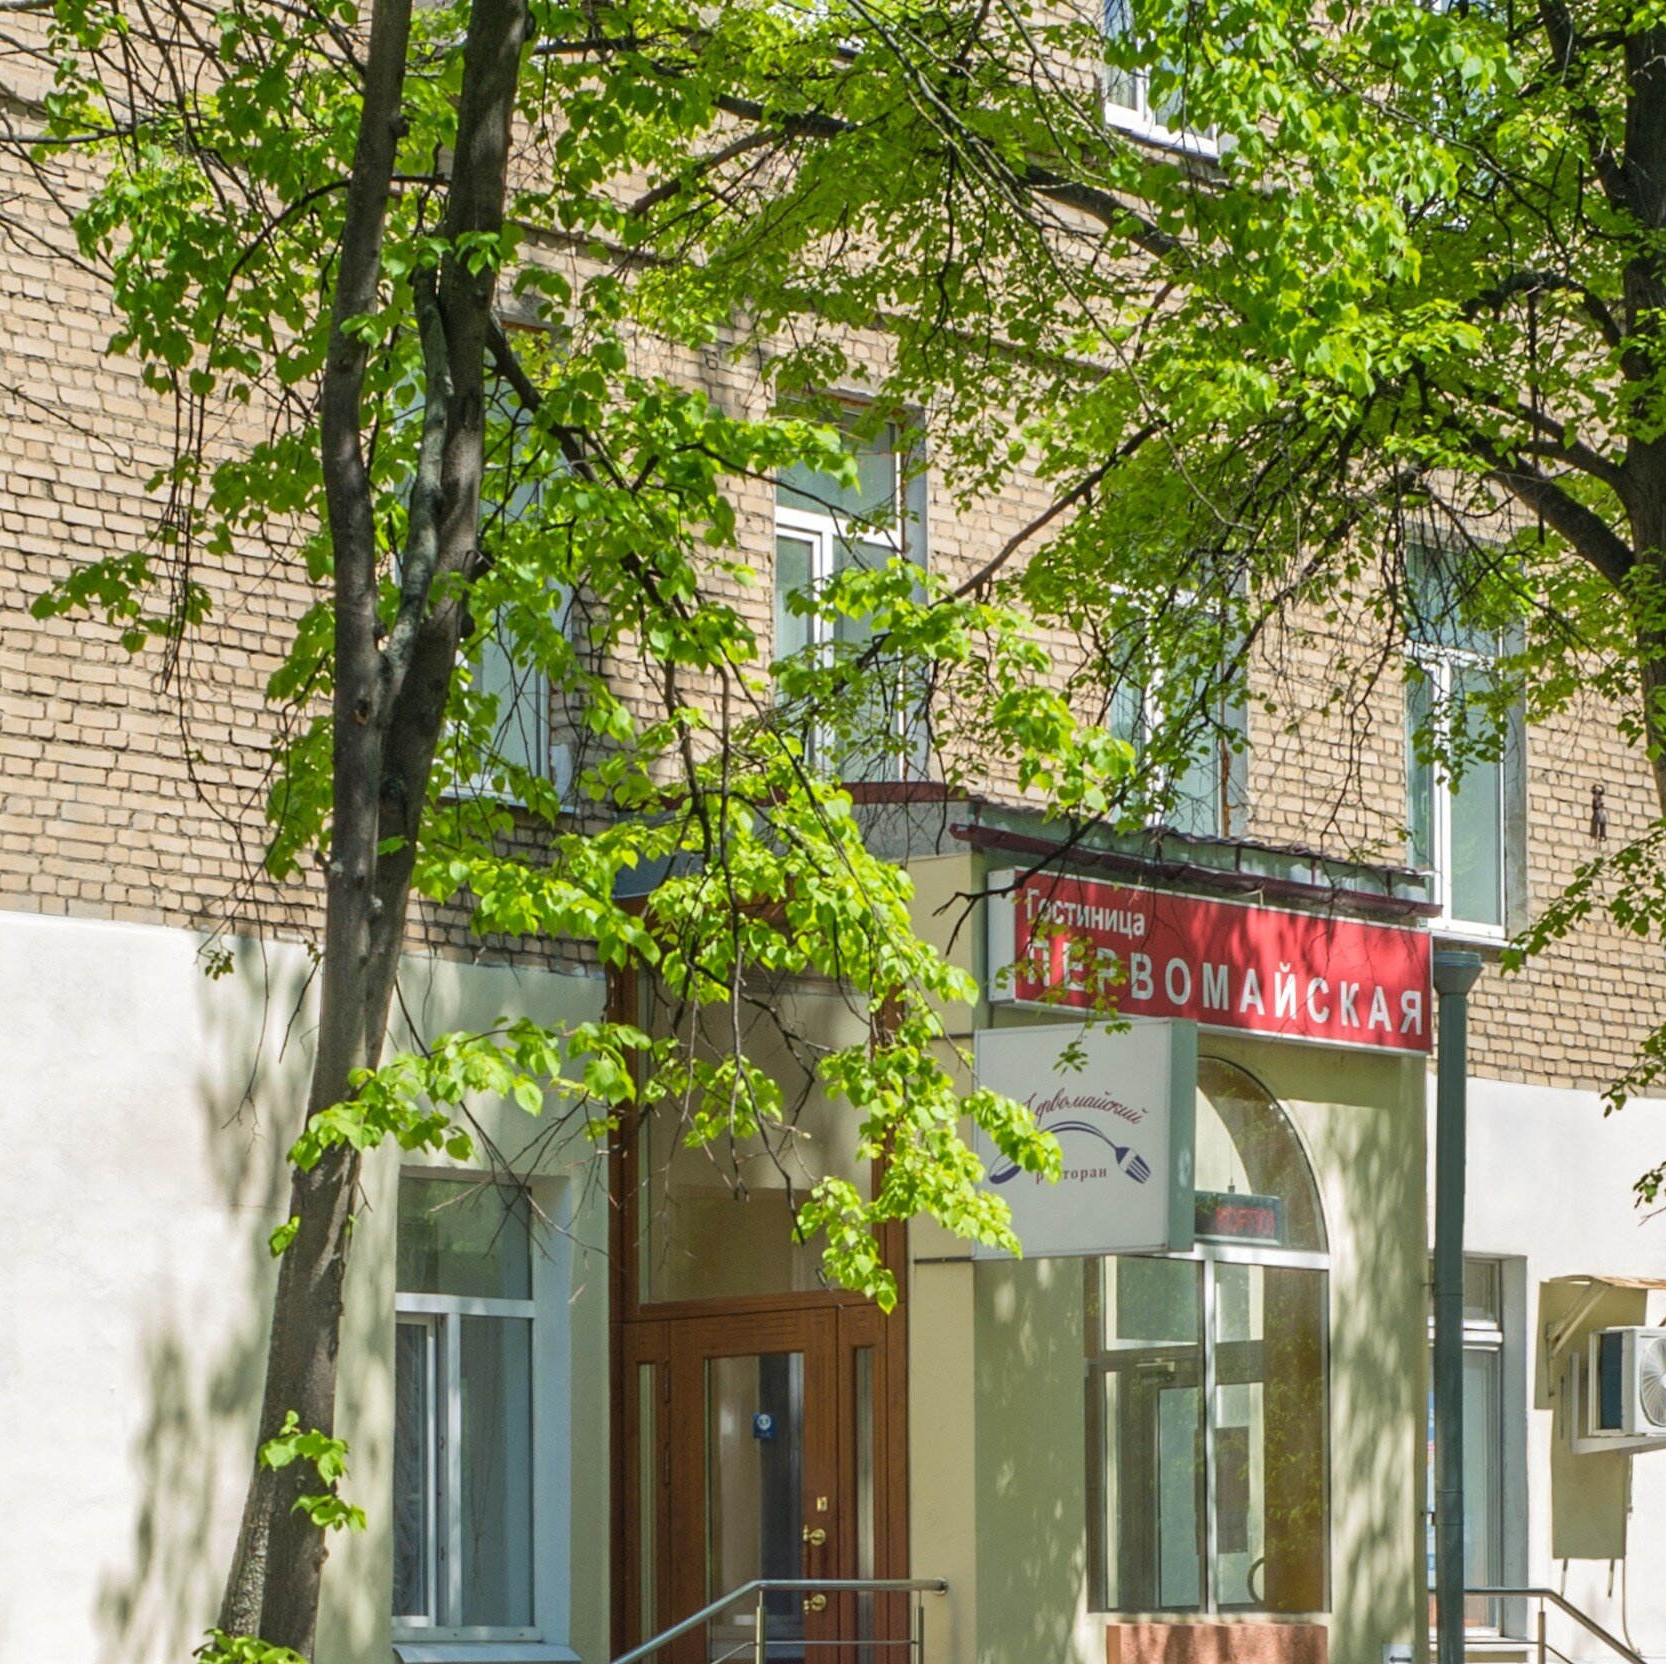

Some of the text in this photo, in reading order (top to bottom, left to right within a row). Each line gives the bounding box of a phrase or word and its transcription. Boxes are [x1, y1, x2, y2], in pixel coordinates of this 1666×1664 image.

[1026, 888, 1147, 940] Гостиница
[1026, 935, 1423, 1036] ПЕРВОМАЙСКАЯ
[1035, 1167, 1107, 1184] рторан
